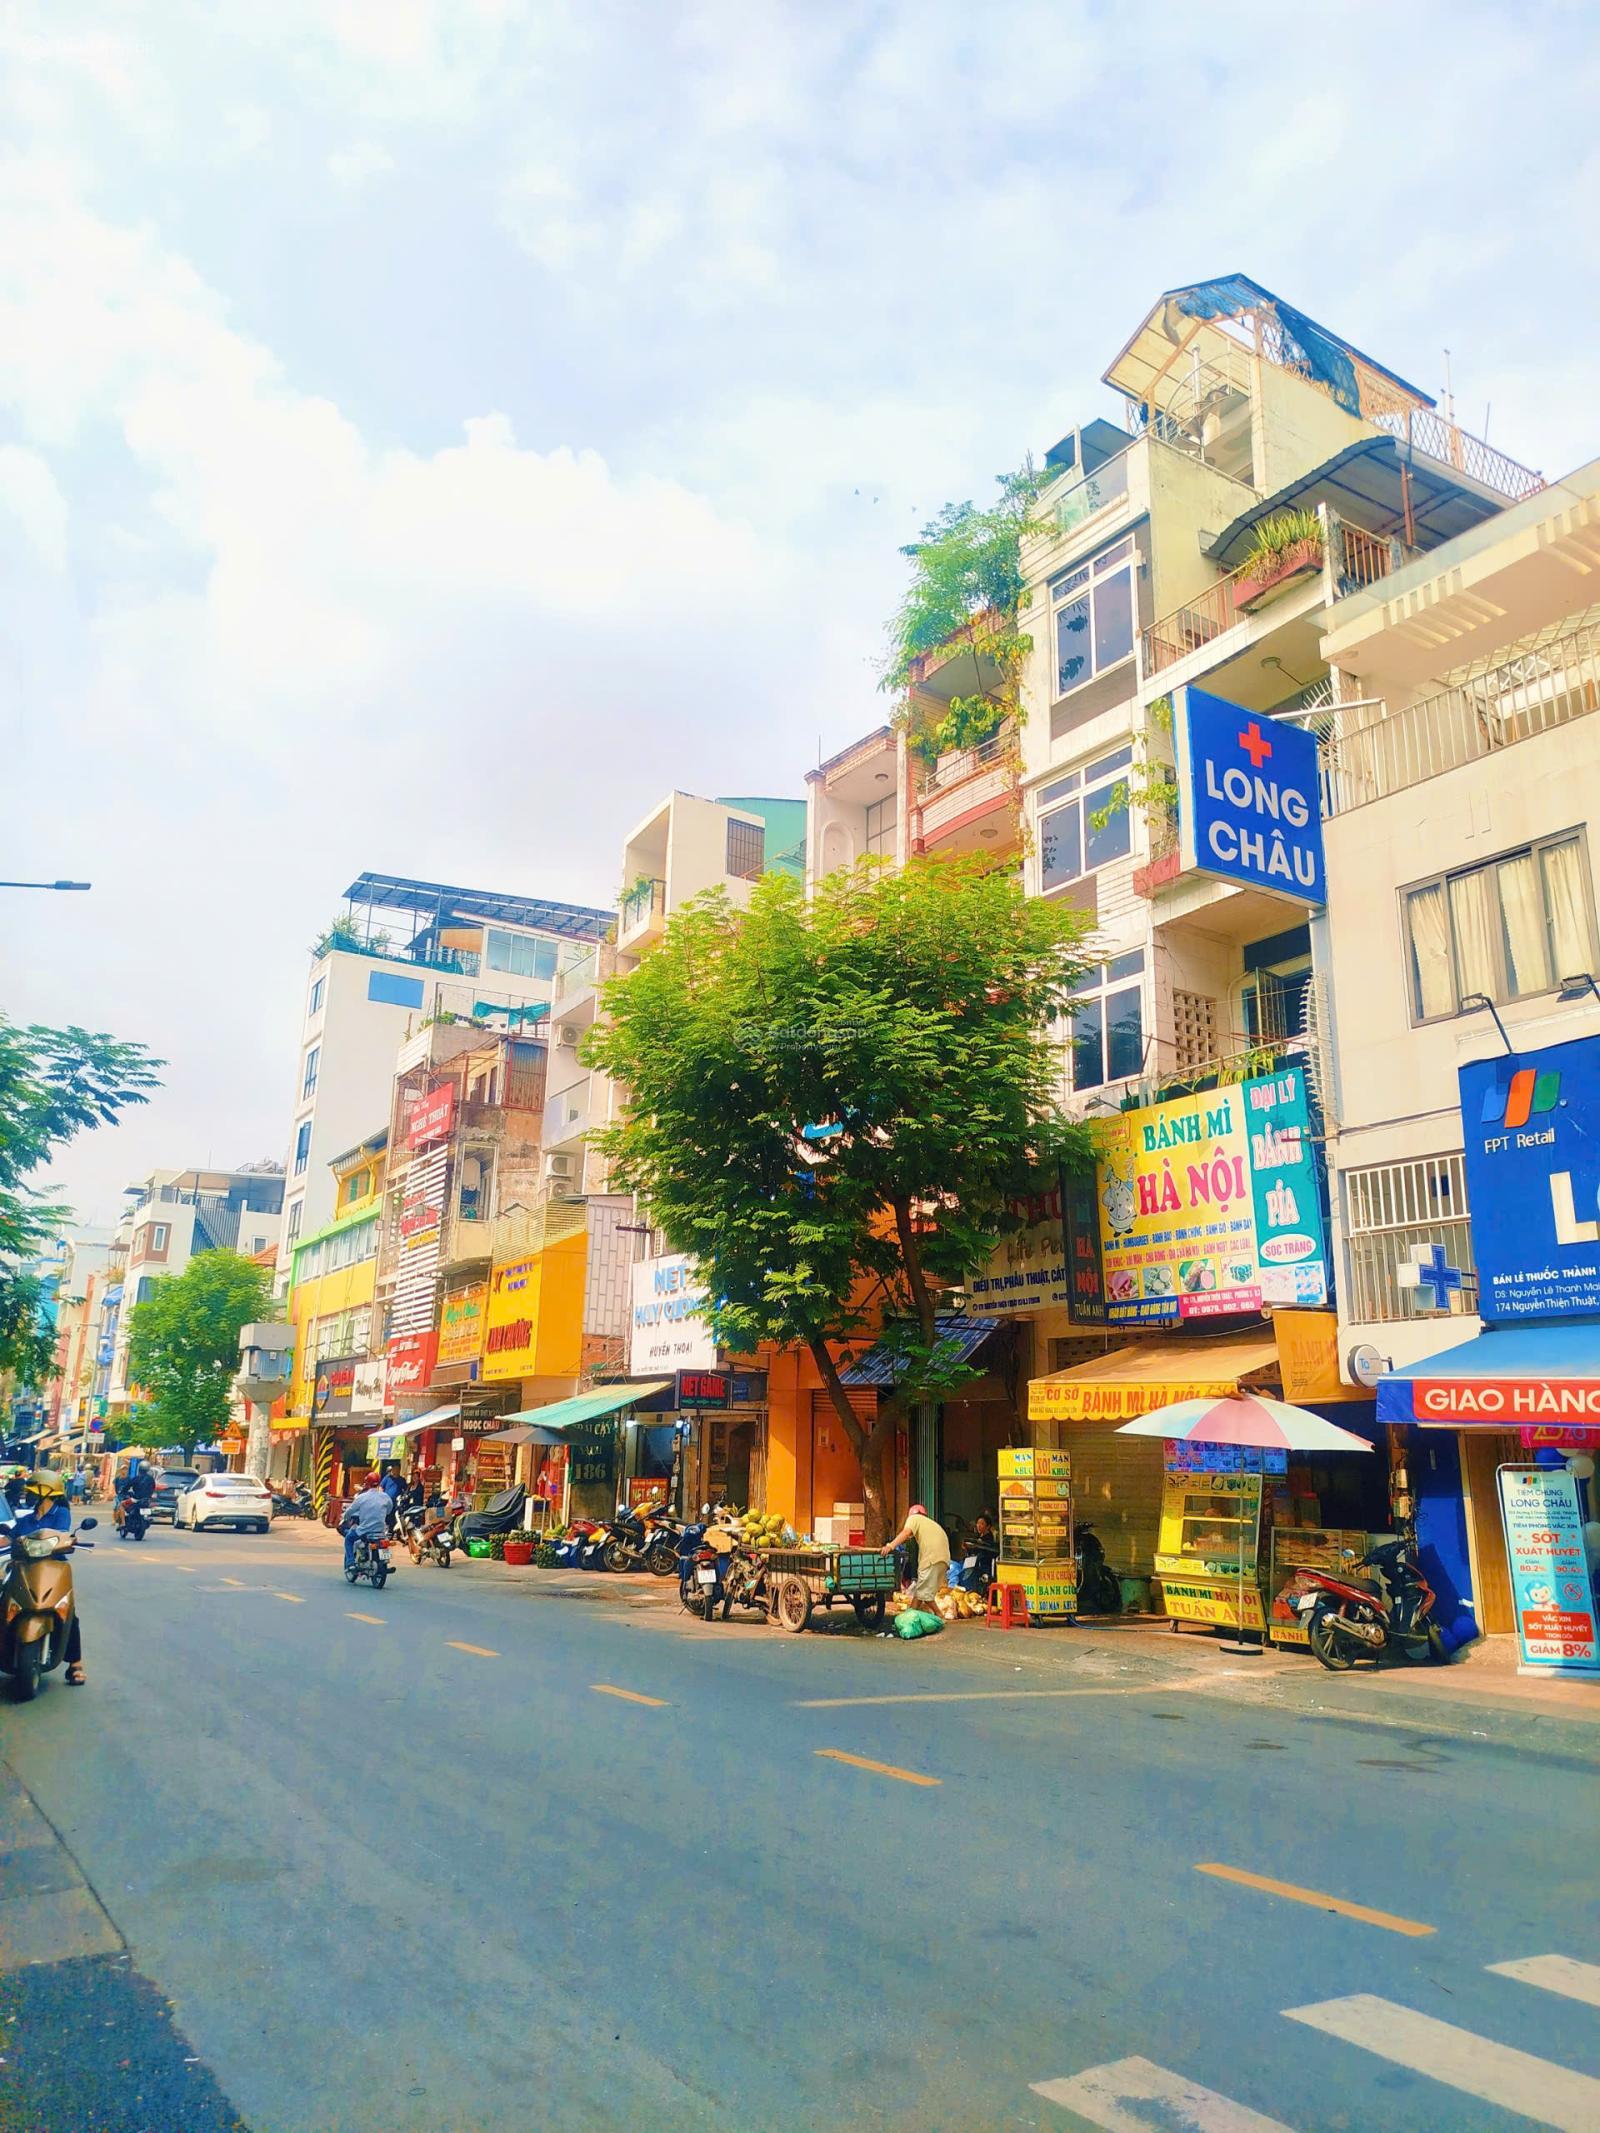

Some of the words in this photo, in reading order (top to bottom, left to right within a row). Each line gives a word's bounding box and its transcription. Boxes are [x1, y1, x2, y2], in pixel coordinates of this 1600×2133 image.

[1206, 759, 1309, 827] LONG
[1208, 820, 1316, 887] CHÂU
[1250, 1086, 1277, 1112] ĐẠI
[1278, 1073, 1296, 1104] LÝ
[1142, 1115, 1201, 1152] BÁNH
[1207, 1099, 1232, 1139] MÌ
[1484, 1136, 1509, 1154] FPT
[1516, 1128, 1555, 1149] Retail
[1137, 1158, 1181, 1216] HÀ
[1187, 1146, 1246, 1213] NỘI
[654, 1265, 689, 1293] NET
[1493, 1273, 1512, 1285] BÁN
[1526, 1265, 1559, 1281] THUỐC
[1562, 1265, 1596, 1278] THÀNH
[1555, 1284, 1582, 1294] Thanh
[1496, 1302, 1511, 1312] 174
[681, 1376, 699, 1397] NET
[700, 1376, 725, 1397] GAME
[1082, 1387, 1122, 1413] BÁNH
[1126, 1385, 1146, 1412] MÌ
[1425, 1388, 1504, 1411] GIAO
[463, 1420, 482, 1432] NGỌC
[575, 1463, 607, 1480] 186
[1510, 1499, 1540, 1508] LONG
[1542, 1497, 1572, 1508] CHÂU
[1169, 1599, 1215, 1618] TUẤN
[1562, 1644, 1591, 1657] 8%
